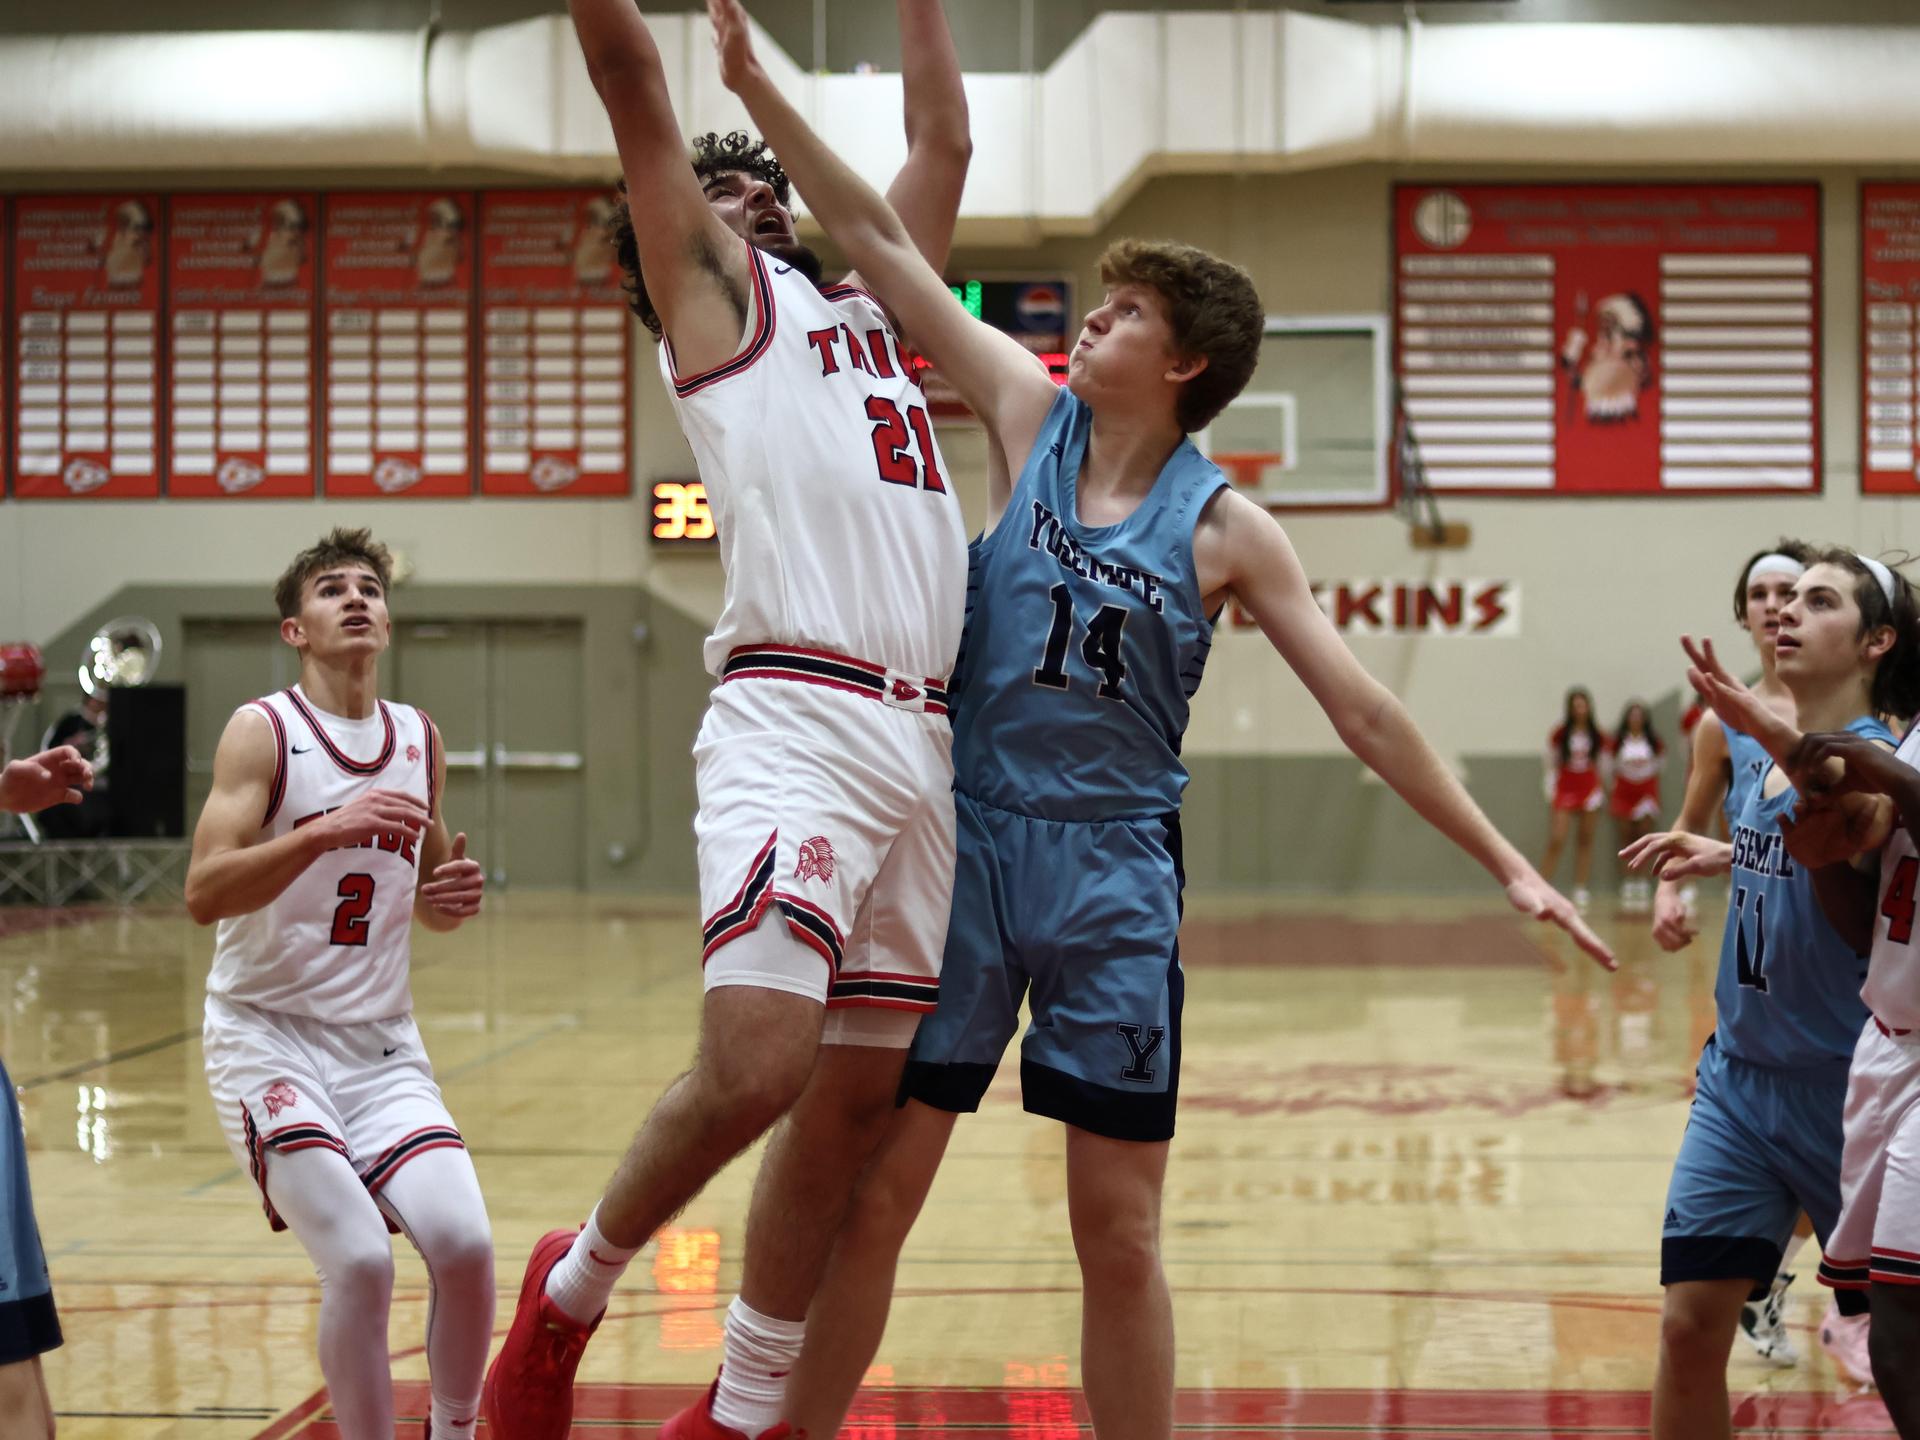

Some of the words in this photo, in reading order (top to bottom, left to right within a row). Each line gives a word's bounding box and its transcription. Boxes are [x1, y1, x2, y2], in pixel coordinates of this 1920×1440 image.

[863, 393, 948, 496] 21
[653, 481, 717, 540] 35
[1028, 499, 1166, 615] YOSEMTE
[1032, 580, 1131, 703] 14
[1310, 580, 1511, 634] KINS
[329, 872, 377, 947] 2
[1734, 884, 1770, 995] 11
[1881, 854, 1920, 946] 4
[1116, 1021, 1166, 1084] Y
